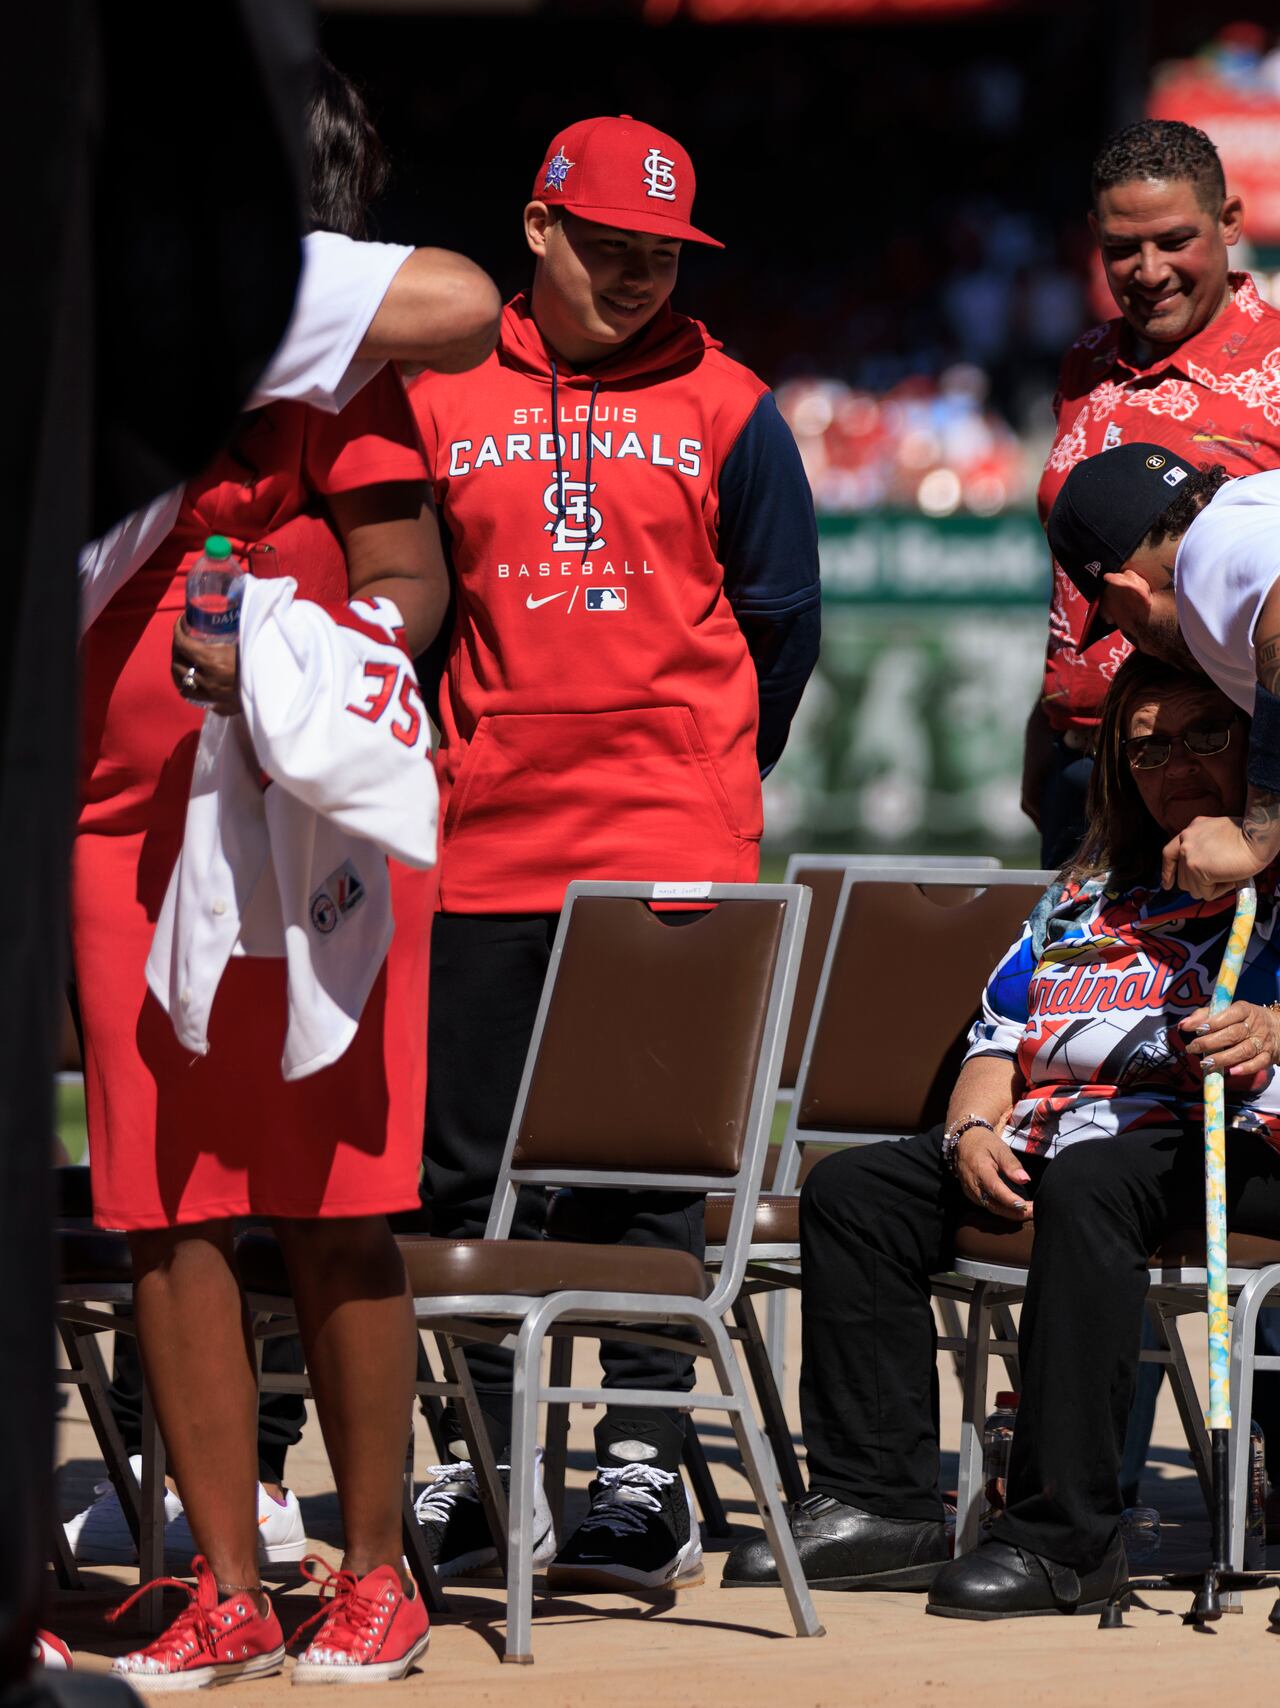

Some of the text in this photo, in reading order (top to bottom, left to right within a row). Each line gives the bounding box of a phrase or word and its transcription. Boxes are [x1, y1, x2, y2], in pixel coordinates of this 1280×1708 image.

[513, 405, 637, 425] ST. LOUIS
[448, 431, 702, 477] CARDINALS
[498, 561, 654, 578] BASEBALL
[1027, 960, 1212, 1017] ardinals
